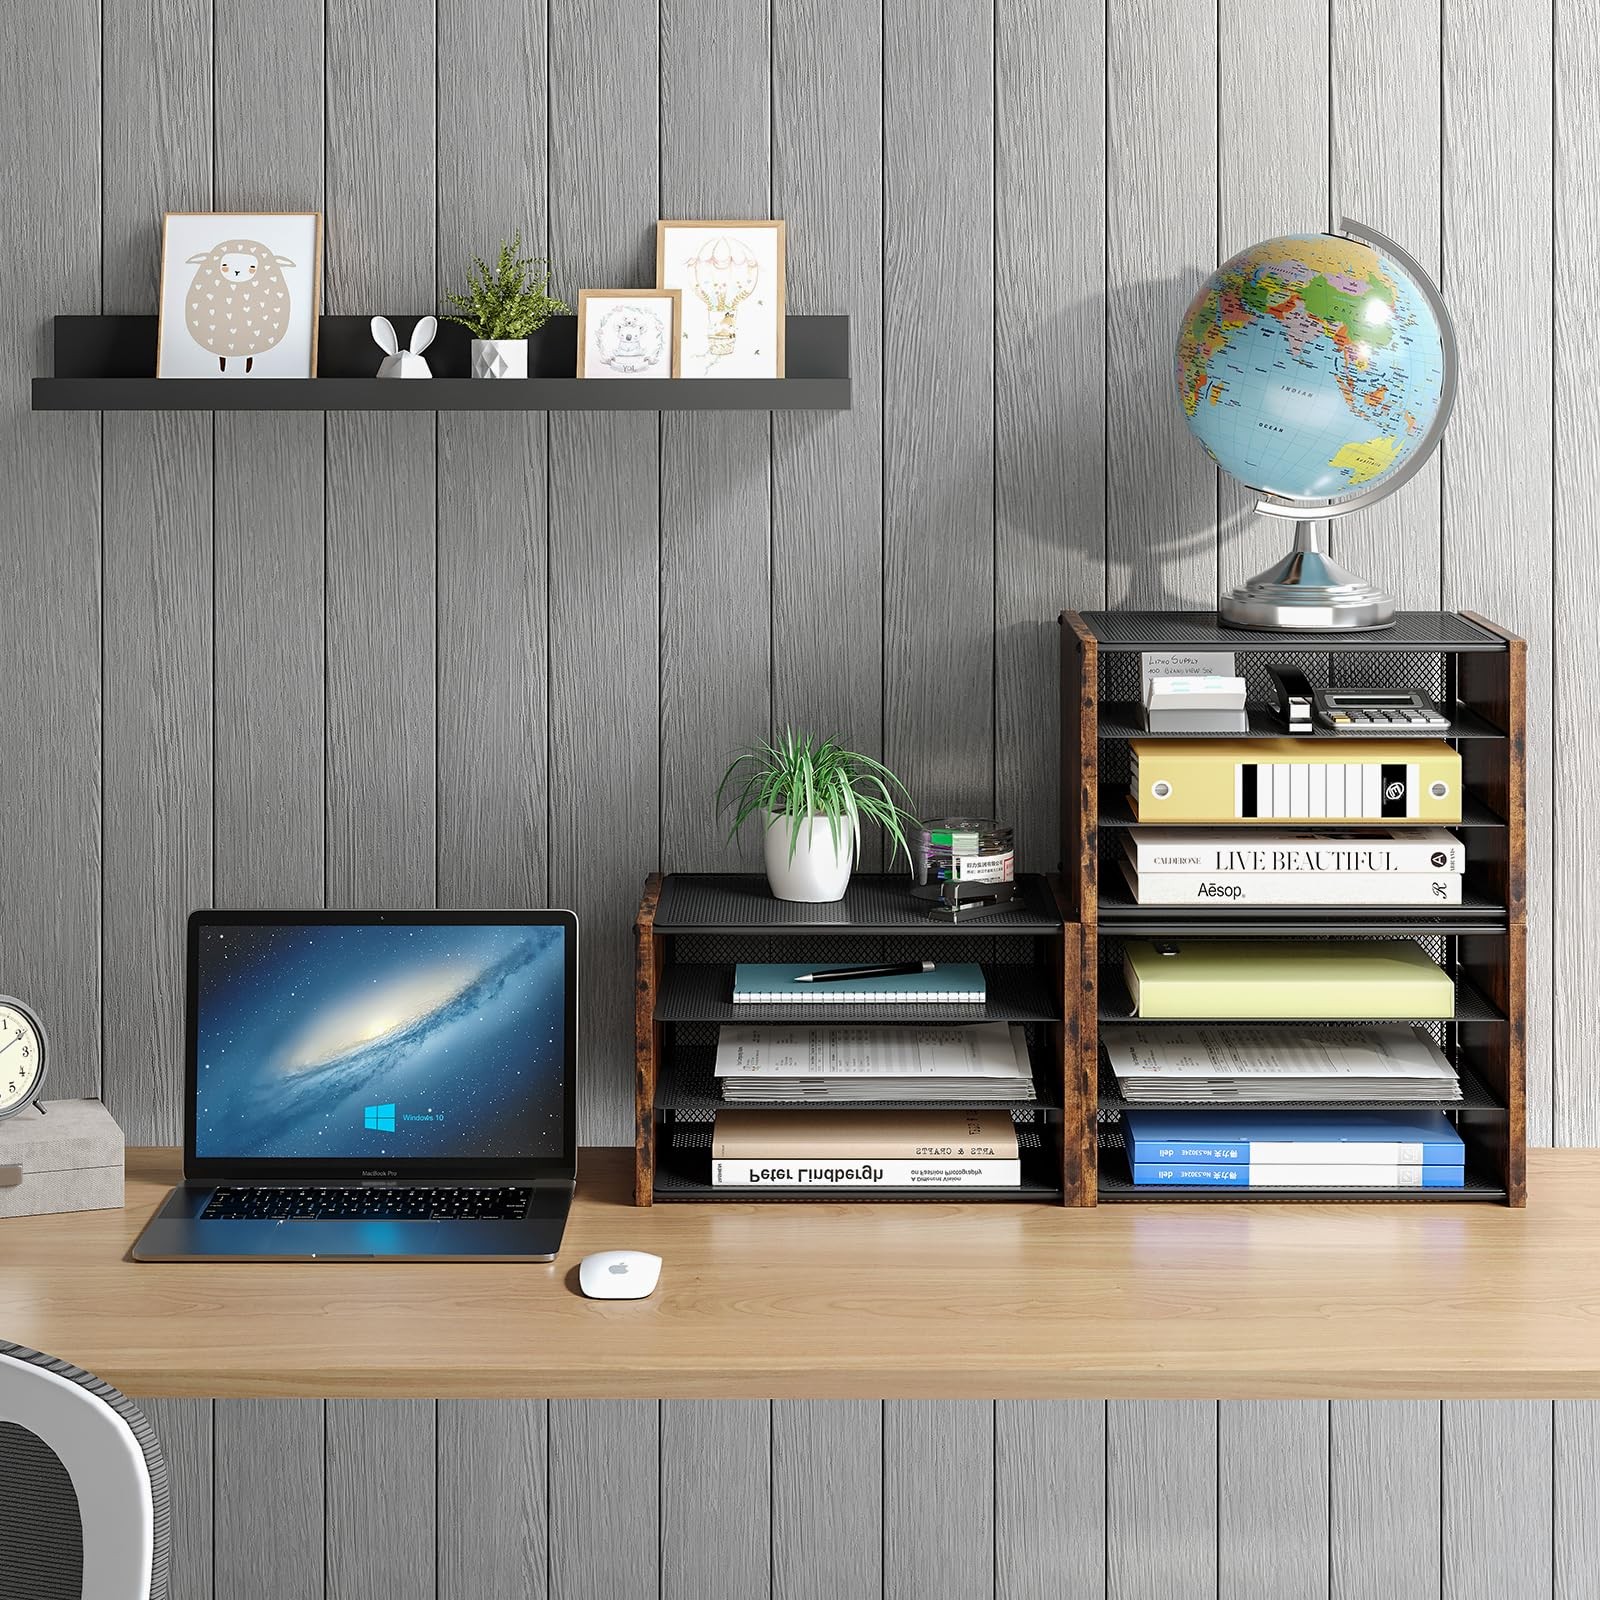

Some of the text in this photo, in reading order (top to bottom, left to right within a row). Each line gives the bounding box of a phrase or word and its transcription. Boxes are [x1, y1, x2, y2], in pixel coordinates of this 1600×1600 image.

[1280, 385, 1314, 399] INDIAN
[1259, 422, 1284, 434] OCEAN
[1153, 851, 1398, 871] CALDERONE LIVE BEAUTIFUL
[3, 1019, 8, 1030] 1
[22, 1046, 29, 1058] 3
[19, 1065, 26, 1077] 4
[9, 1081, 16, 1093] 5
[1159, 1149, 1174, 1157] deli
[1158, 1171, 1174, 1179] deli
